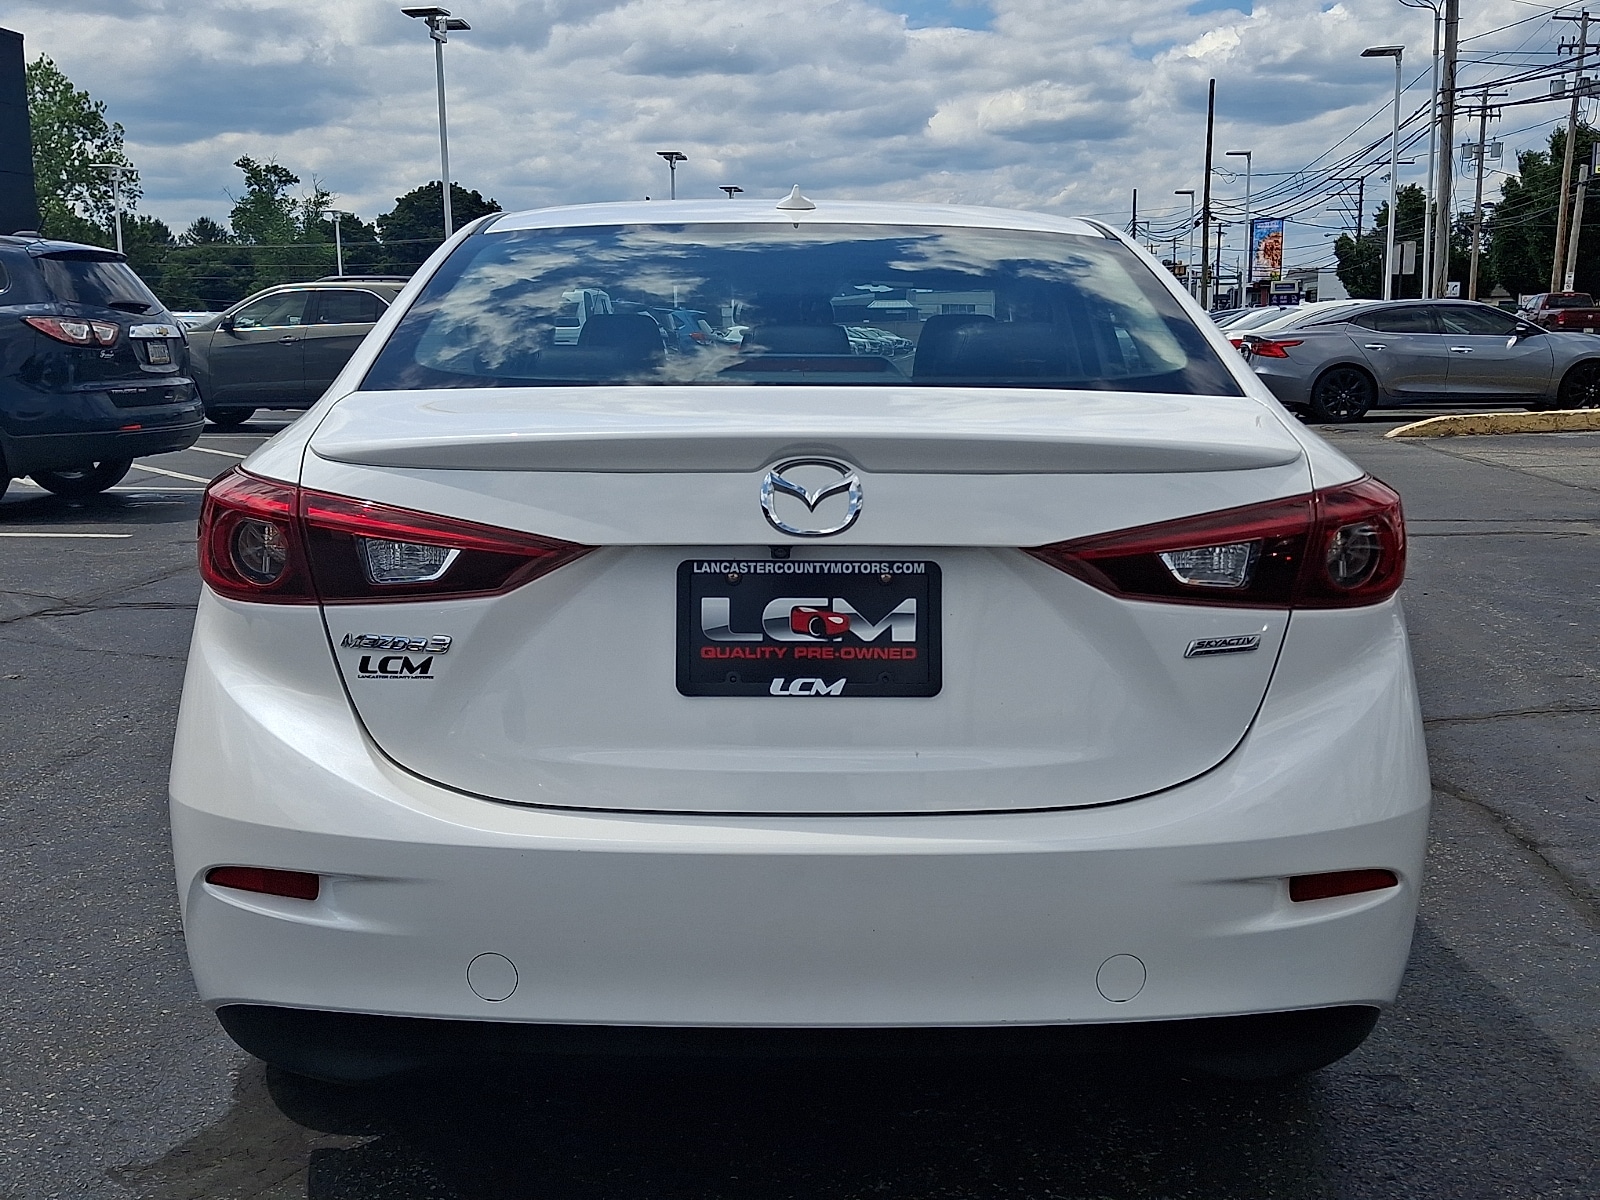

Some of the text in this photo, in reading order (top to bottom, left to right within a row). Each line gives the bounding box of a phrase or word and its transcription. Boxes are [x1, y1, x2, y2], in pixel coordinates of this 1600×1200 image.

[693, 562, 925, 574] LANCASTERCOUNTYMOTORS.COM
[1196, 637, 1256, 648] SKYACTIV
[701, 647, 917, 660] QUALITY PRE-OWNED
[358, 656, 434, 674] LCM
[769, 678, 847, 696] LCM
